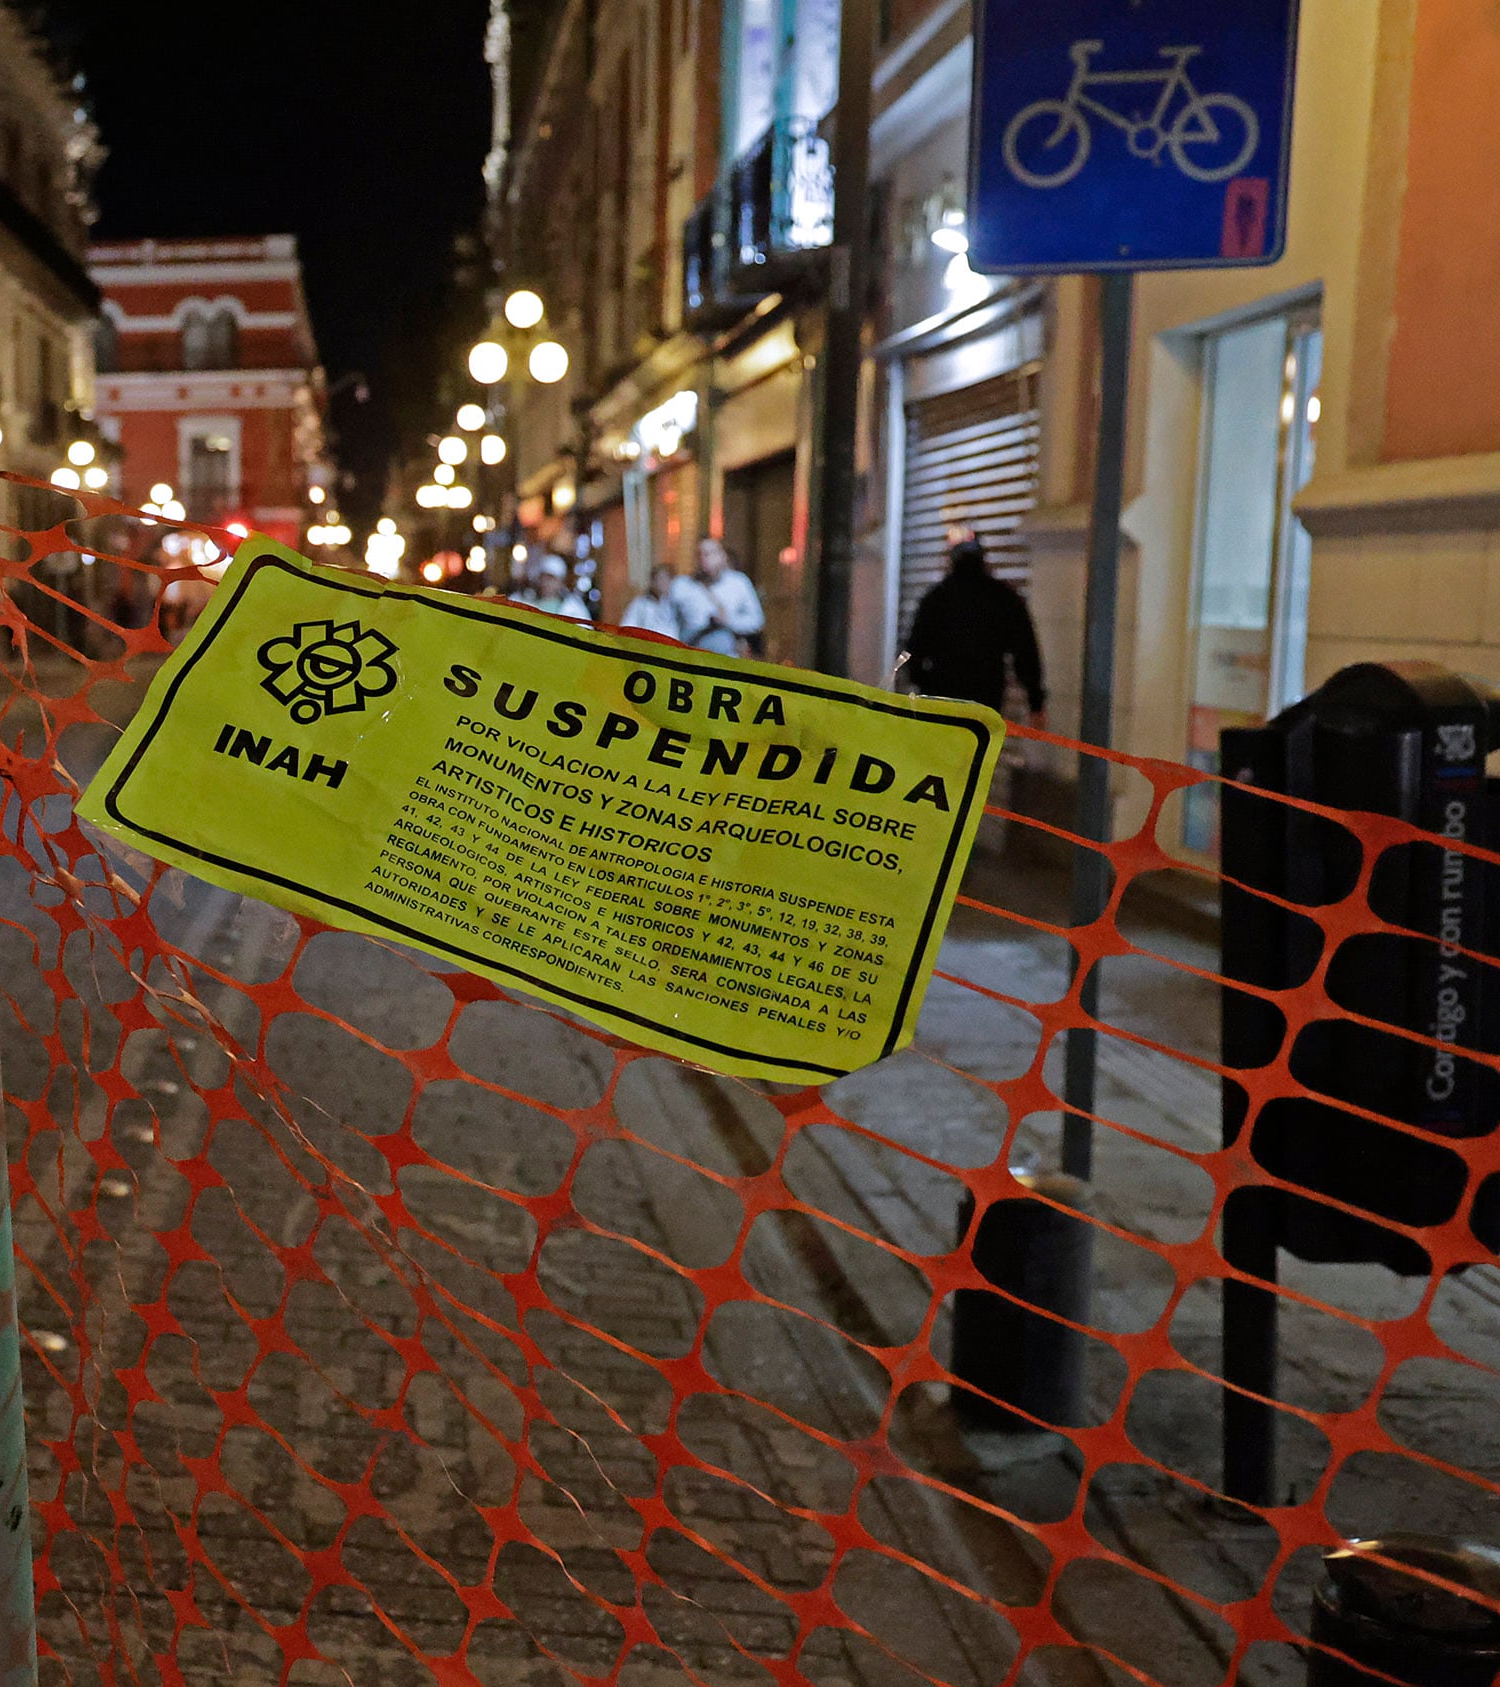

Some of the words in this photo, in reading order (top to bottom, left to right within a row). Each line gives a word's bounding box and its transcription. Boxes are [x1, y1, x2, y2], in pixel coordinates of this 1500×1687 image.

[443, 663, 950, 813] SUSPENDIDA
[622, 669, 787, 727] OBRA
[213, 723, 349, 790] INAH
[431, 759, 555, 825] ARTISTICOS
[558, 814, 576, 833] E
[578, 821, 713, 863] HISTORICOS
[444, 737, 594, 805] MONUMENTOS
[601, 793, 615, 810] Y
[615, 799, 694, 832] ZONAS
[456, 715, 501, 742] POR
[507, 735, 621, 783] VIOLACION
[622, 774, 637, 788] A
[643, 779, 671, 797] LA
[677, 787, 721, 807] LEY
[723, 792, 825, 821] FEDERAL
[832, 808, 917, 841] SOBRE
[409, 791, 445, 812] OBRA
[448, 806, 476, 825] CON
[477, 820, 565, 866] FUNDAMENTO
[567, 861, 586, 875] EN
[588, 867, 615, 883] LOS
[616, 873, 694, 900] ARTICULOS
[415, 775, 431, 790] EL
[434, 783, 500, 819] INSTITUTO
[500, 815, 565, 851] NACIONAL
[568, 844, 588, 857] DE
[588, 849, 695, 883] ANTROPOLOGIA
[698, 874, 709, 886] E
[710, 877, 775, 900] HISTORIA
[778, 891, 856, 920] SUSPENDE
[858, 911, 895, 929] ESTA
[450, 825, 466, 837] 43
[472, 833, 481, 844] Y
[485, 843, 500, 855] 44
[505, 852, 525, 866] DE
[530, 862, 547, 876] LA
[553, 871, 581, 888] LEY
[585, 885, 646, 909] FEDERAL
[653, 900, 702, 921] SOBRE
[708, 913, 810, 949] MONUMENTOS
[818, 941, 828, 952] Y
[833, 944, 884, 966] ZONAS
[363, 881, 480, 935] ADMINISTRATIVAS
[482, 930, 624, 992] CORRESPONDIENTES.
[371, 865, 468, 912] AUTORIDADES
[476, 906, 485, 918] Y
[491, 912, 511, 928] SE
[517, 922, 536, 937] LE
[541, 933, 622, 973] APLICARAN
[628, 969, 657, 987] LAS
[664, 981, 750, 1013] SANCIONES
[757, 1006, 827, 1033] PENALES
[837, 1026, 861, 1041] Y/O
[379, 849, 441, 883] PERSONA
[448, 877, 477, 895] QUE
[484, 892, 566, 931] QUEBRANTE
[573, 928, 608, 949] ESTE
[670, 964, 707, 983] SERA
[716, 976, 811, 1011] CONSIGNADA
[818, 1004, 829, 1015] A
[837, 1008, 868, 1024] LAS
[482, 875, 512, 893] POR
[517, 887, 587, 924] VIOLACION
[590, 920, 600, 930] A
[606, 925, 647, 947] TALES
[651, 940, 773, 980] ORDENAMIENTOS
[853, 991, 872, 1006] LA
[513, 872, 592, 910] ARTISTICOS
[597, 906, 607, 917] E
[612, 911, 695, 939] HISTORICOS
[702, 931, 711, 942] Y
[769, 950, 786, 963] 44
[793, 955, 803, 967] Y
[808, 960, 825, 973] 46
[831, 965, 852, 979] DE
[857, 971, 879, 985] SU
[1438, 963, 1468, 984] y
[1439, 908, 1462, 958] con
